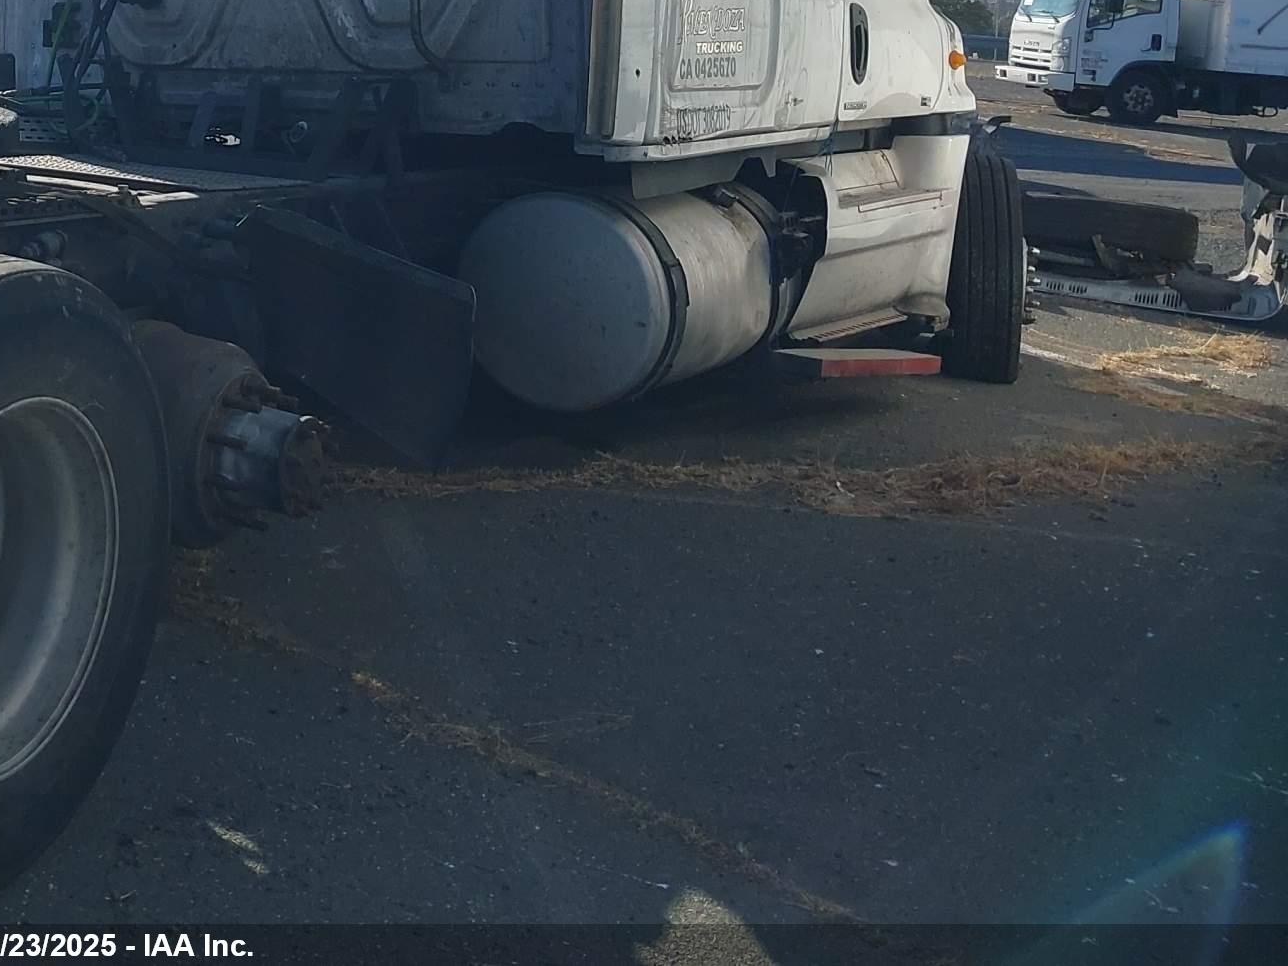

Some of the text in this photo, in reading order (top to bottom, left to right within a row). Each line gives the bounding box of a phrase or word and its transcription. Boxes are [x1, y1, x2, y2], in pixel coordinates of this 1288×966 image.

[696, 40, 743, 54] TRUCKING
[679, 56, 736, 80] CA 0425670
